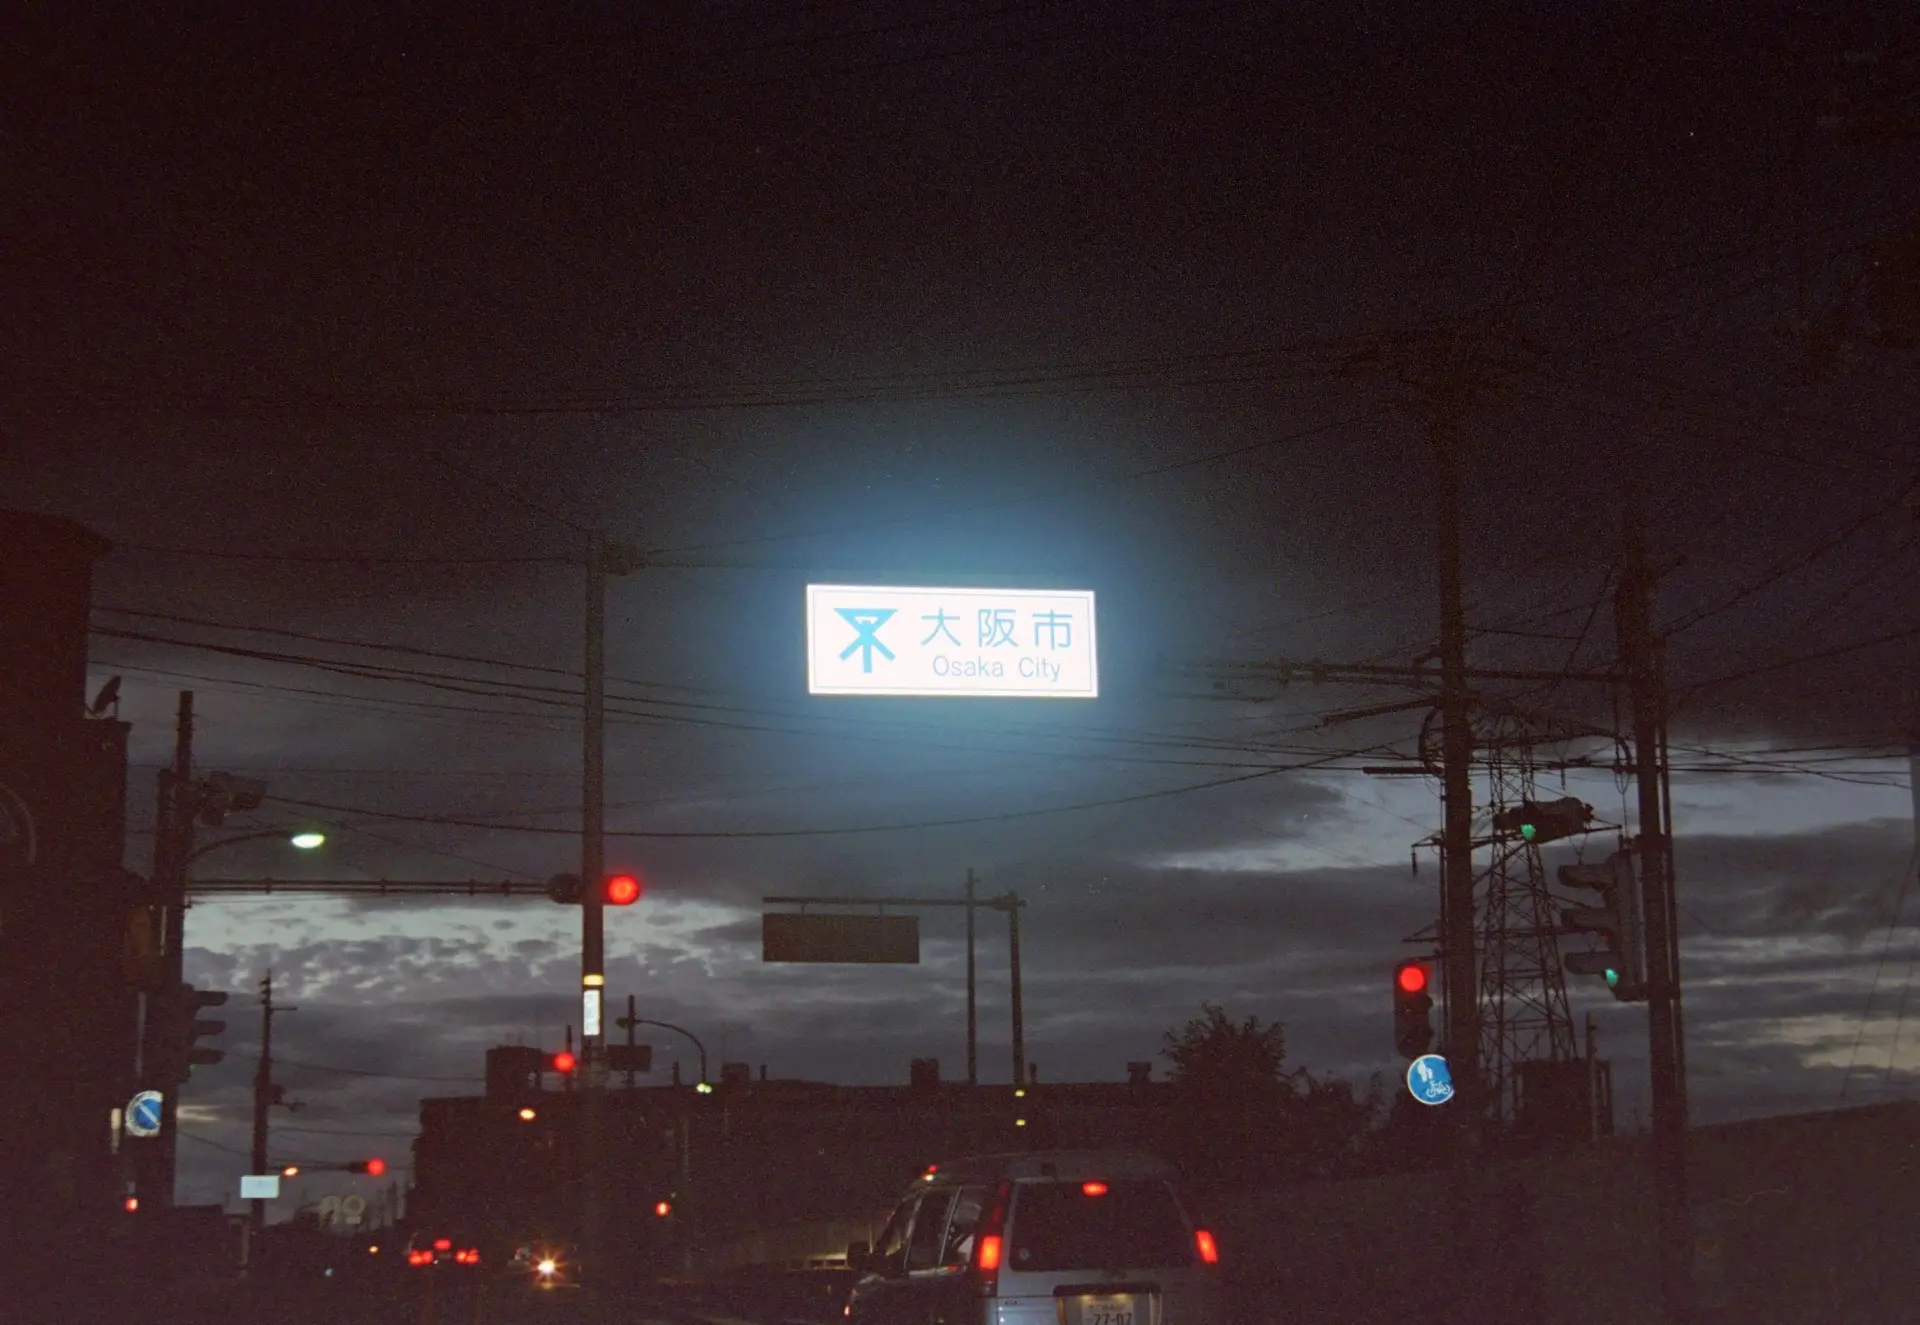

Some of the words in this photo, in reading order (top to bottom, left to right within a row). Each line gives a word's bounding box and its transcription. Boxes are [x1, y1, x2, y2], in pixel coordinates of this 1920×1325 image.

[920, 607, 1073, 650] 大阪市
[932, 655, 1004, 678] Osaka
[1018, 657, 1060, 682] City
